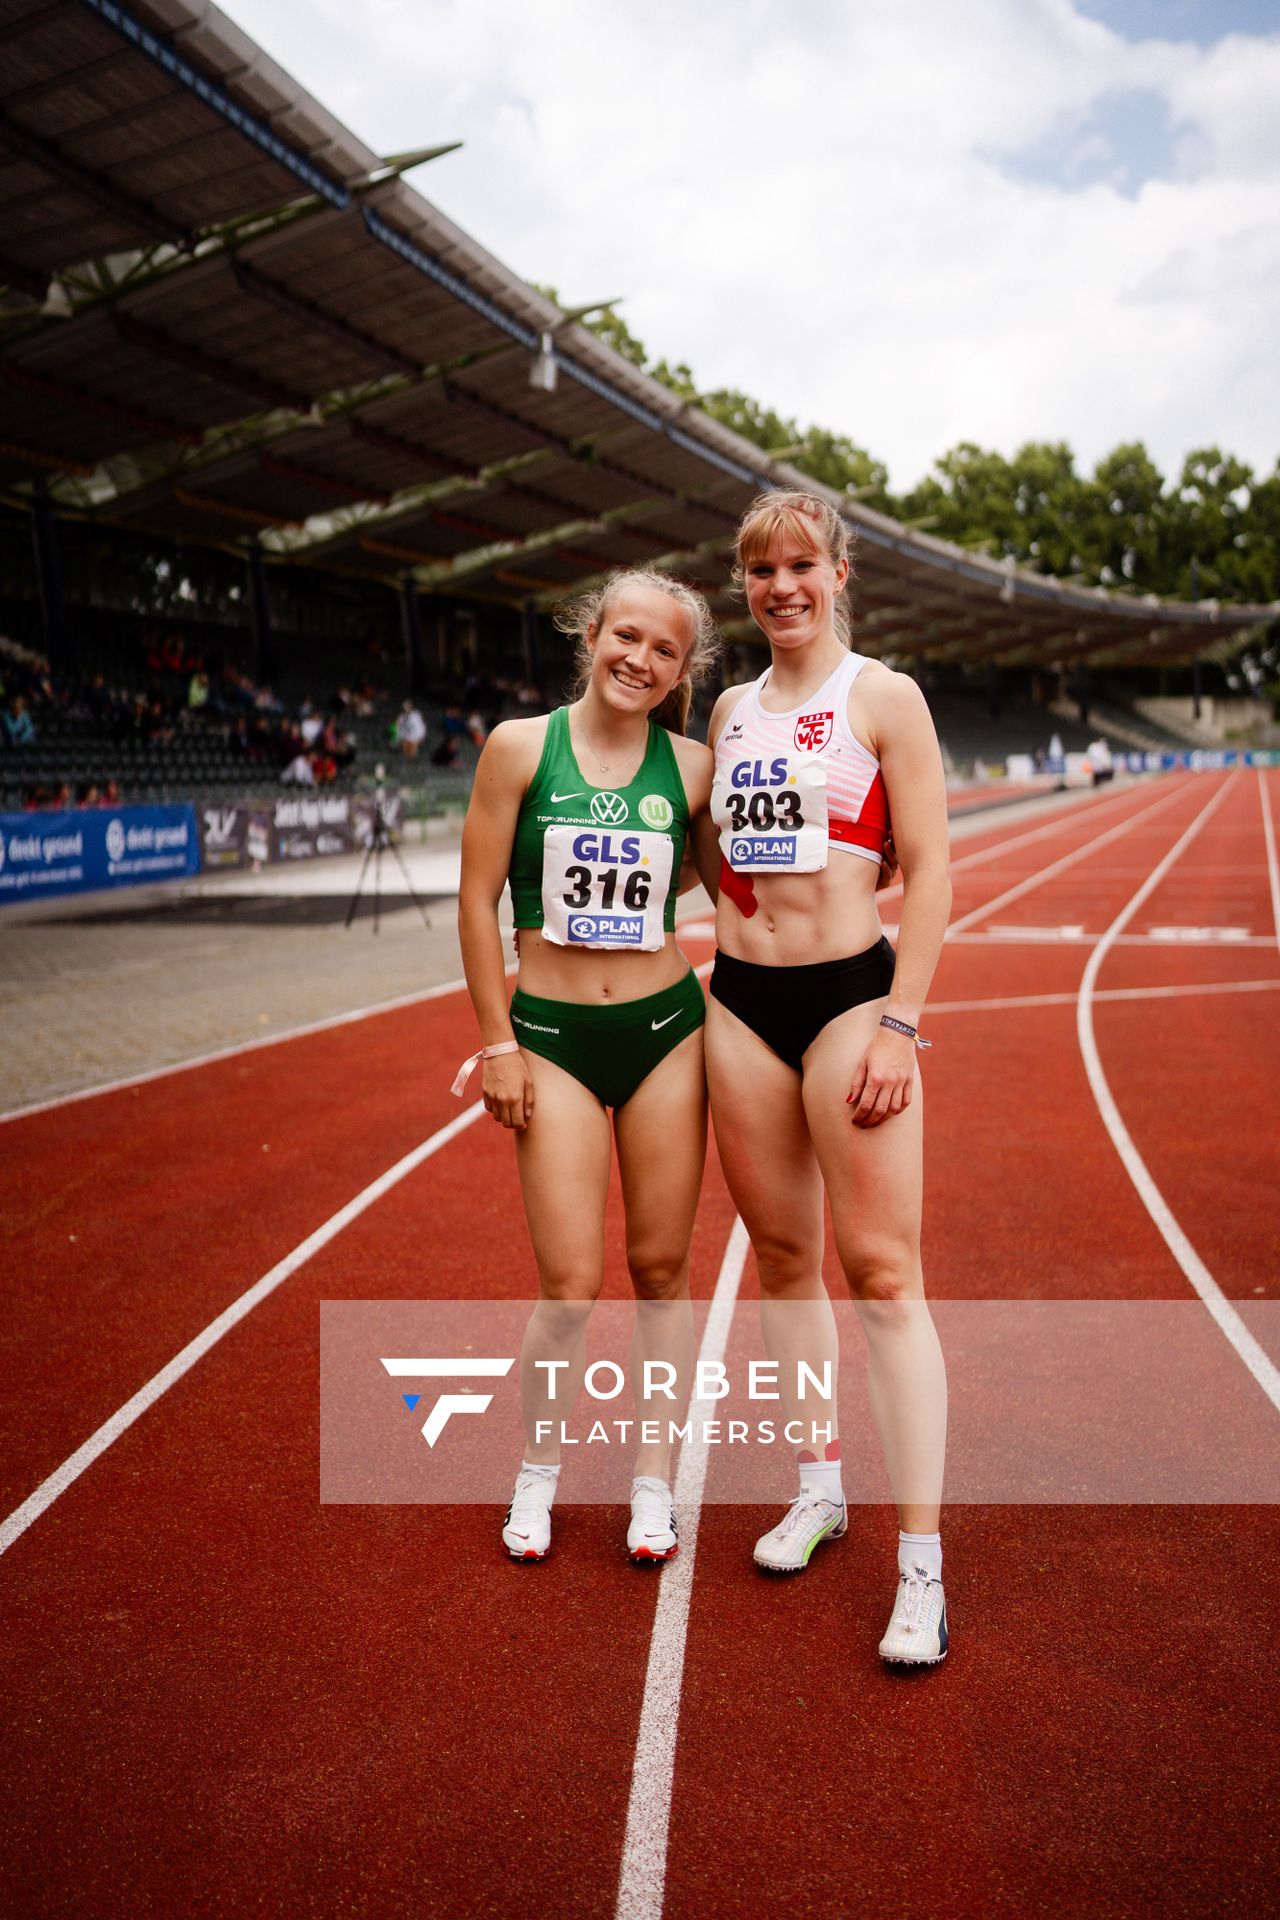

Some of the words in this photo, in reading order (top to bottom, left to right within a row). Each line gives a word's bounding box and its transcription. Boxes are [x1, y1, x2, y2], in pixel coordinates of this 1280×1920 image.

[725, 790, 805, 832] 303
[754, 842, 793, 854] PLAN
[563, 865, 652, 911] 316
[599, 920, 641, 934] PLAN
